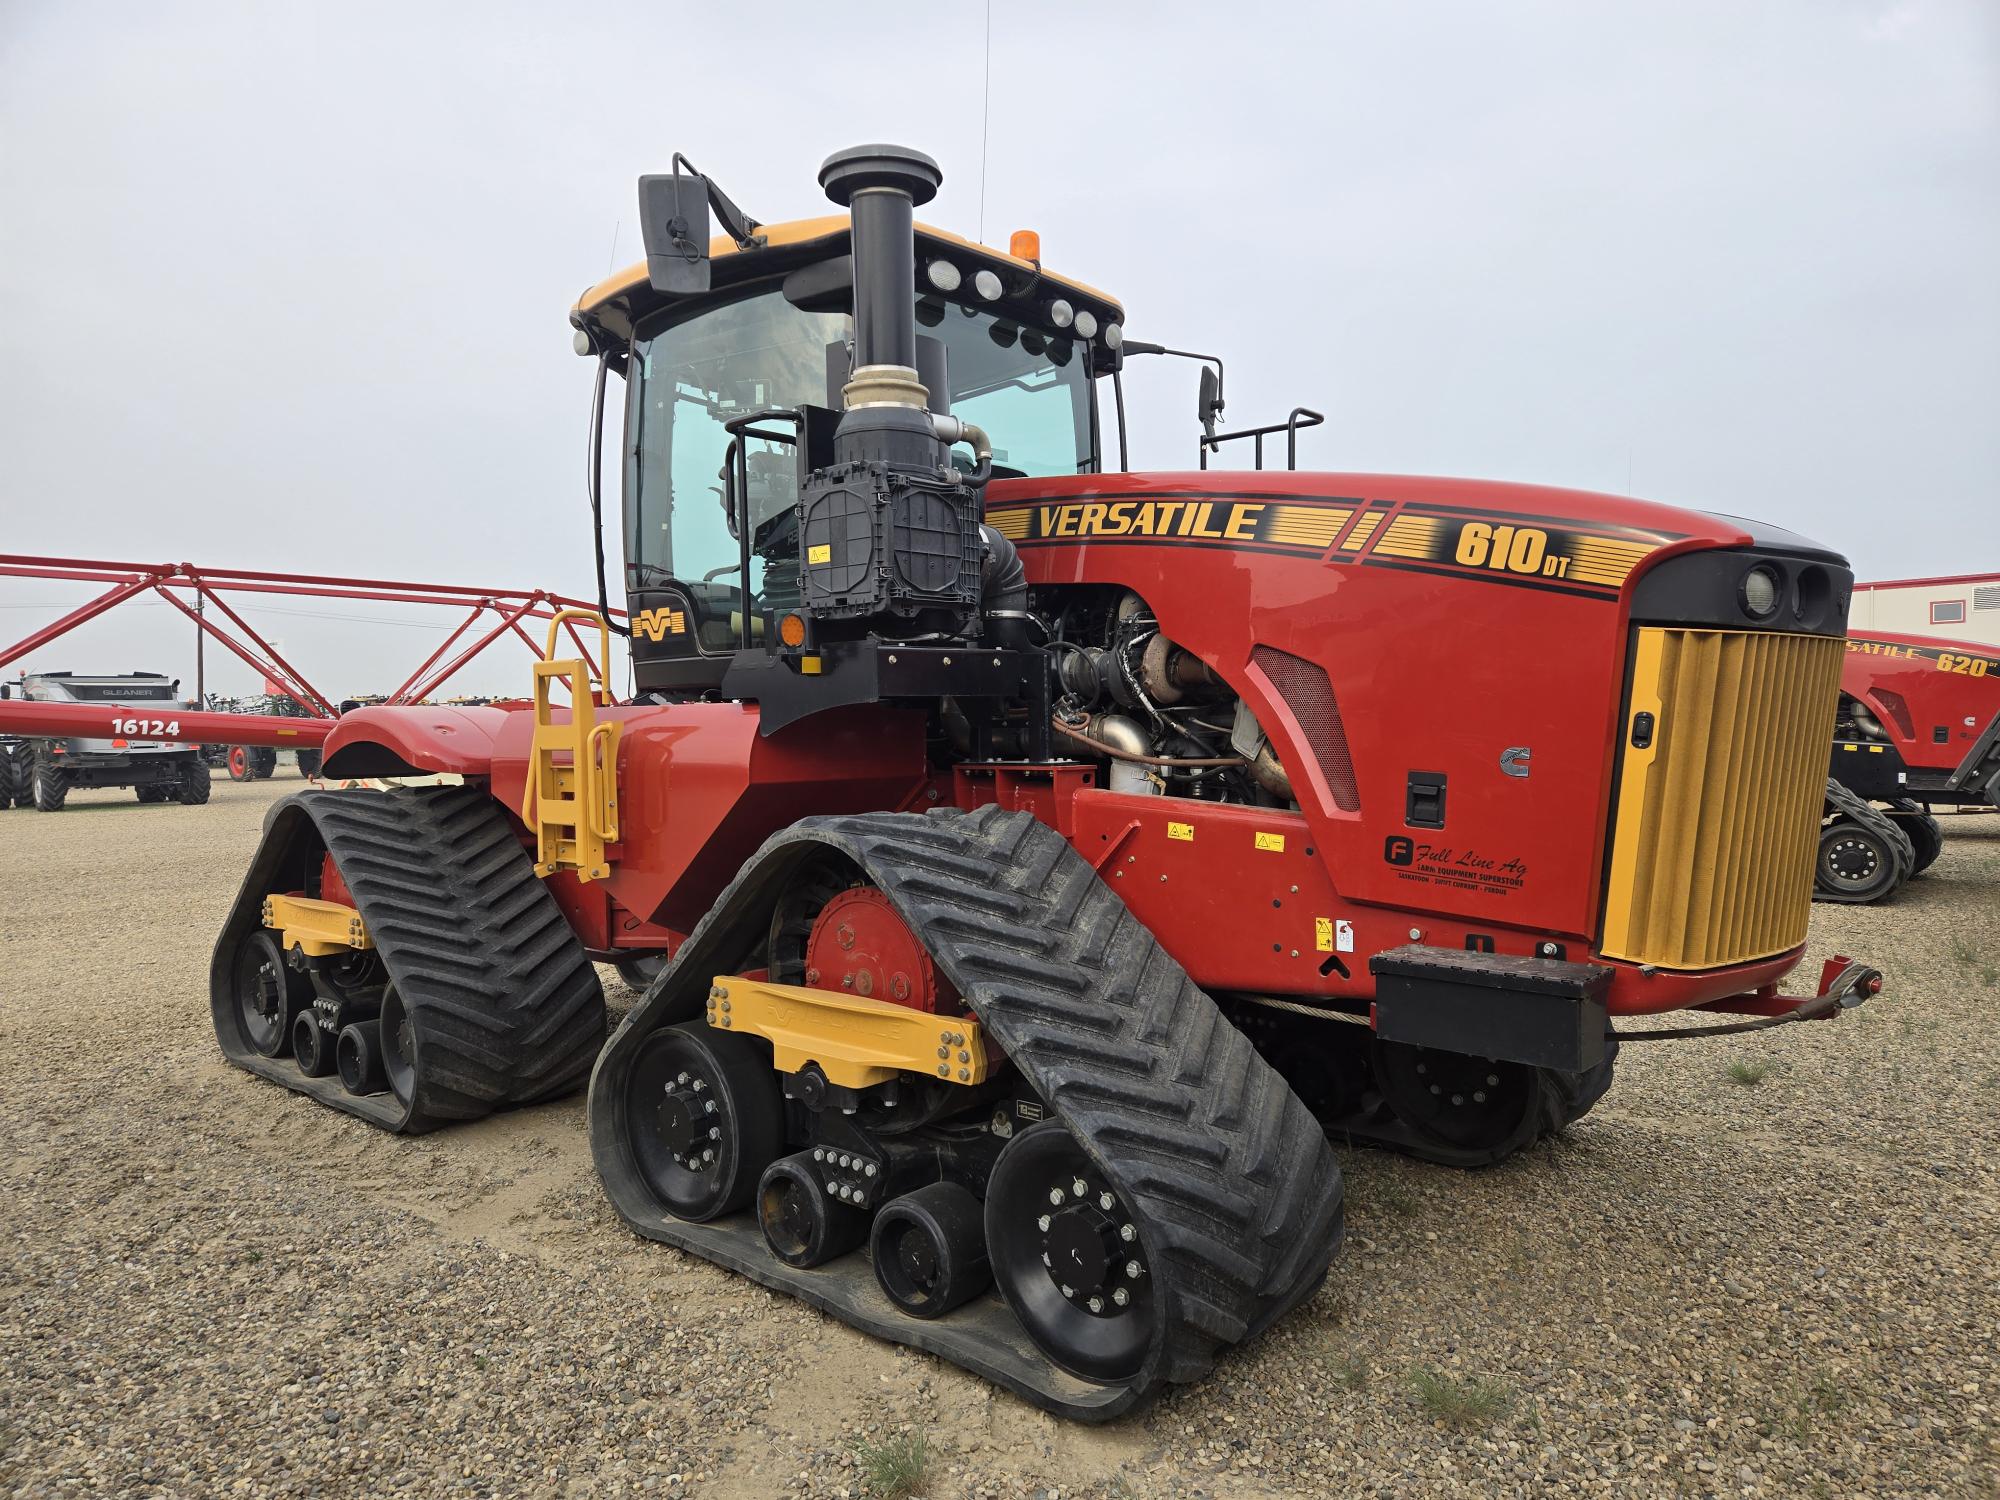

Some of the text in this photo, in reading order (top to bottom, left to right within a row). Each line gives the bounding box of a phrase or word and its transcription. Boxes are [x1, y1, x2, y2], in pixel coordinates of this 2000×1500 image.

[1039, 502, 1266, 540] VERSATILE
[1455, 522, 1571, 578] 610 DT
[1936, 653, 1989, 677] 620
[111, 718, 180, 736] 16124
[1416, 844, 1528, 879] Full Line Ag
[1437, 866, 1477, 880] EQUIPMENT
[1478, 873, 1524, 888] SUPERSTORE
